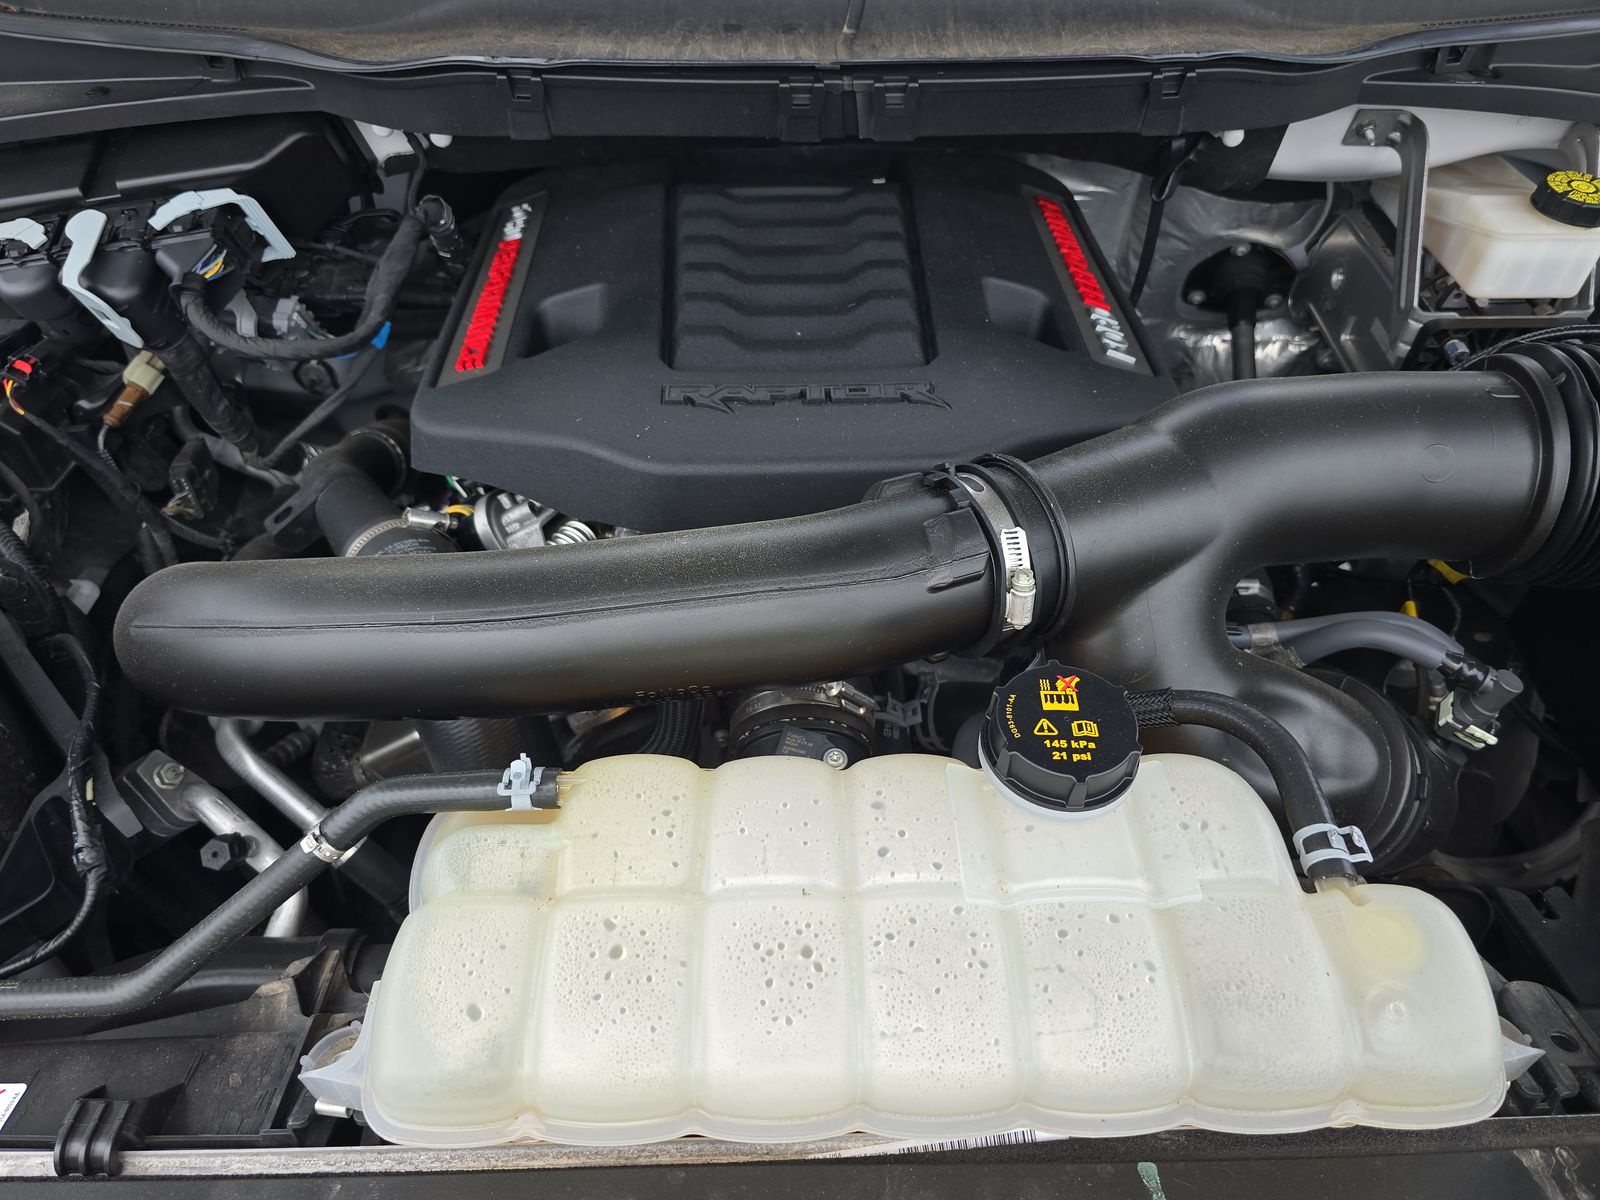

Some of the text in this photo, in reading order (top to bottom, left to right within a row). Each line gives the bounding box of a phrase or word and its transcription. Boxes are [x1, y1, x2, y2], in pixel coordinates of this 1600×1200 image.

[660, 383, 953, 414] RAPTOR
[1044, 740, 1096, 749] 145 kPa
[1052, 751, 1092, 762] 21 psi
